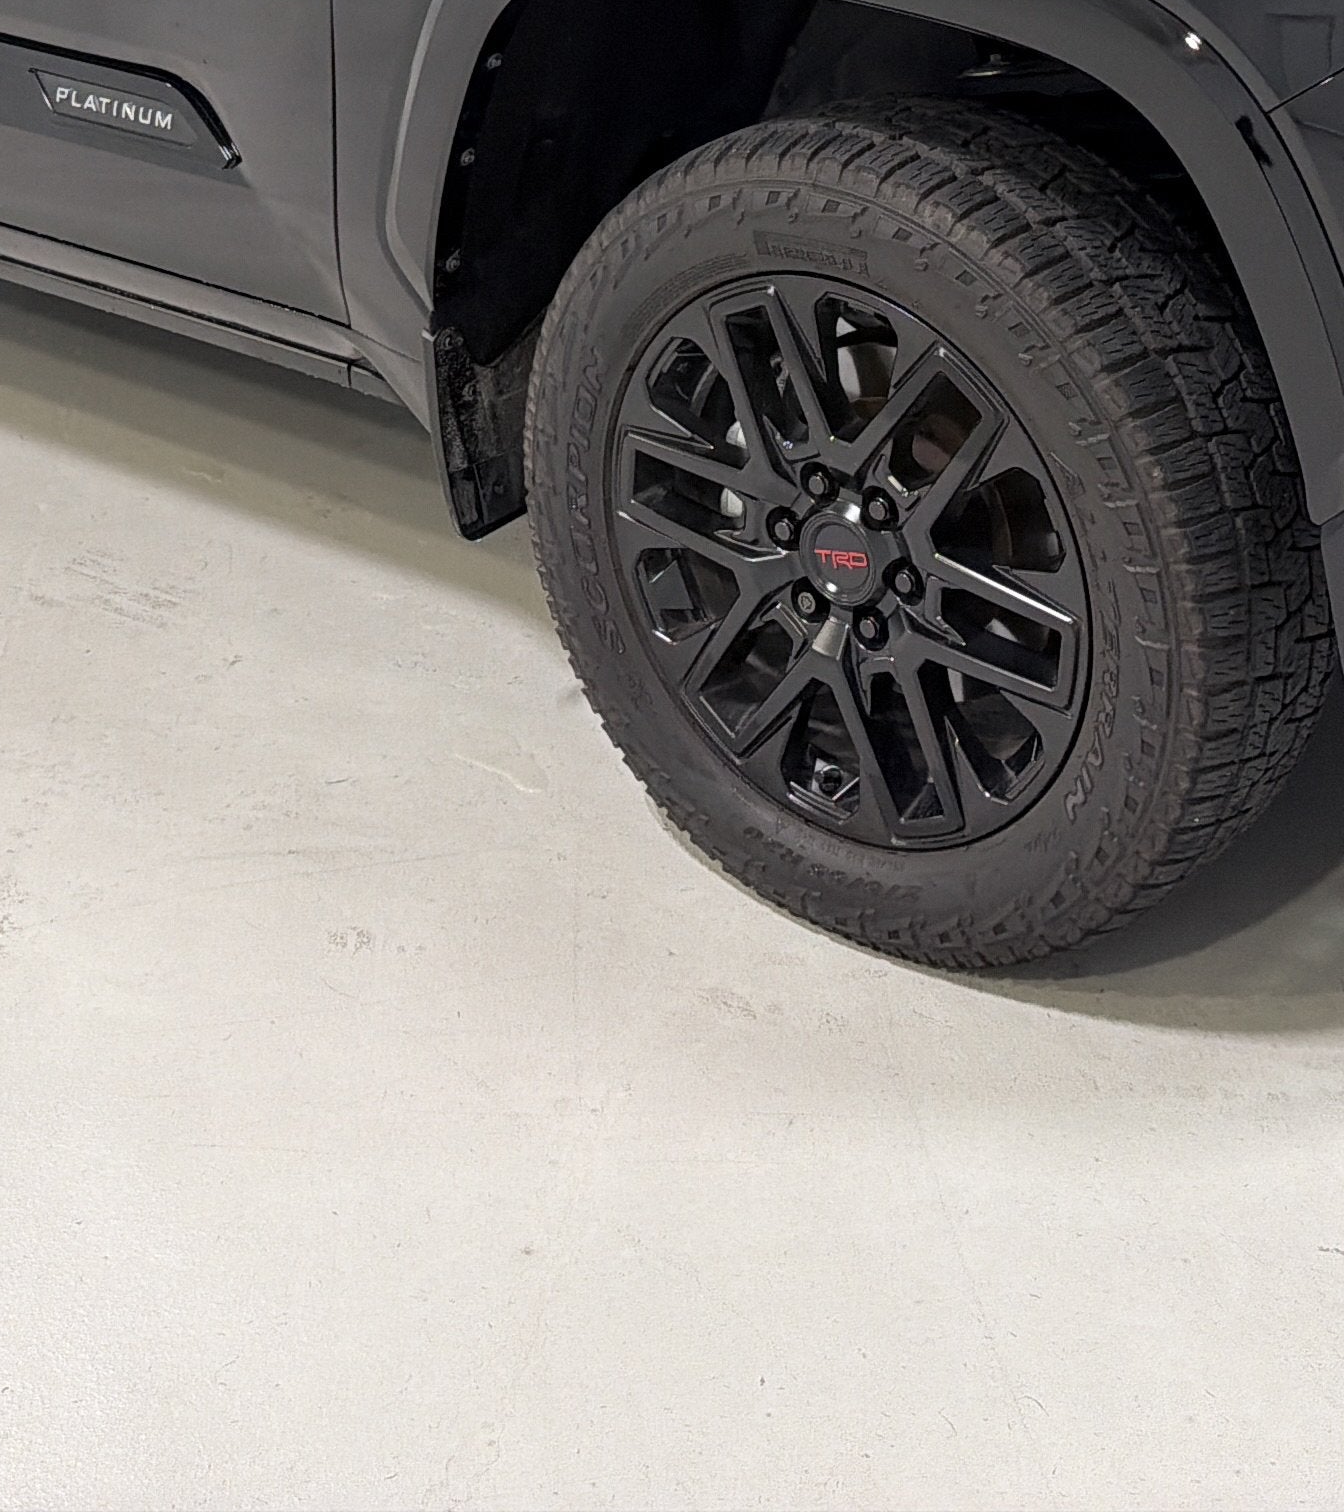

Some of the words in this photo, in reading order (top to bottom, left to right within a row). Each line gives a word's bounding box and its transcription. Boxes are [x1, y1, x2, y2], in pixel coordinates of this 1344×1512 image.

[56, 87, 173, 130] PLATINUM
[568, 346, 625, 655] SCORPION
[814, 549, 868, 569] TRD
